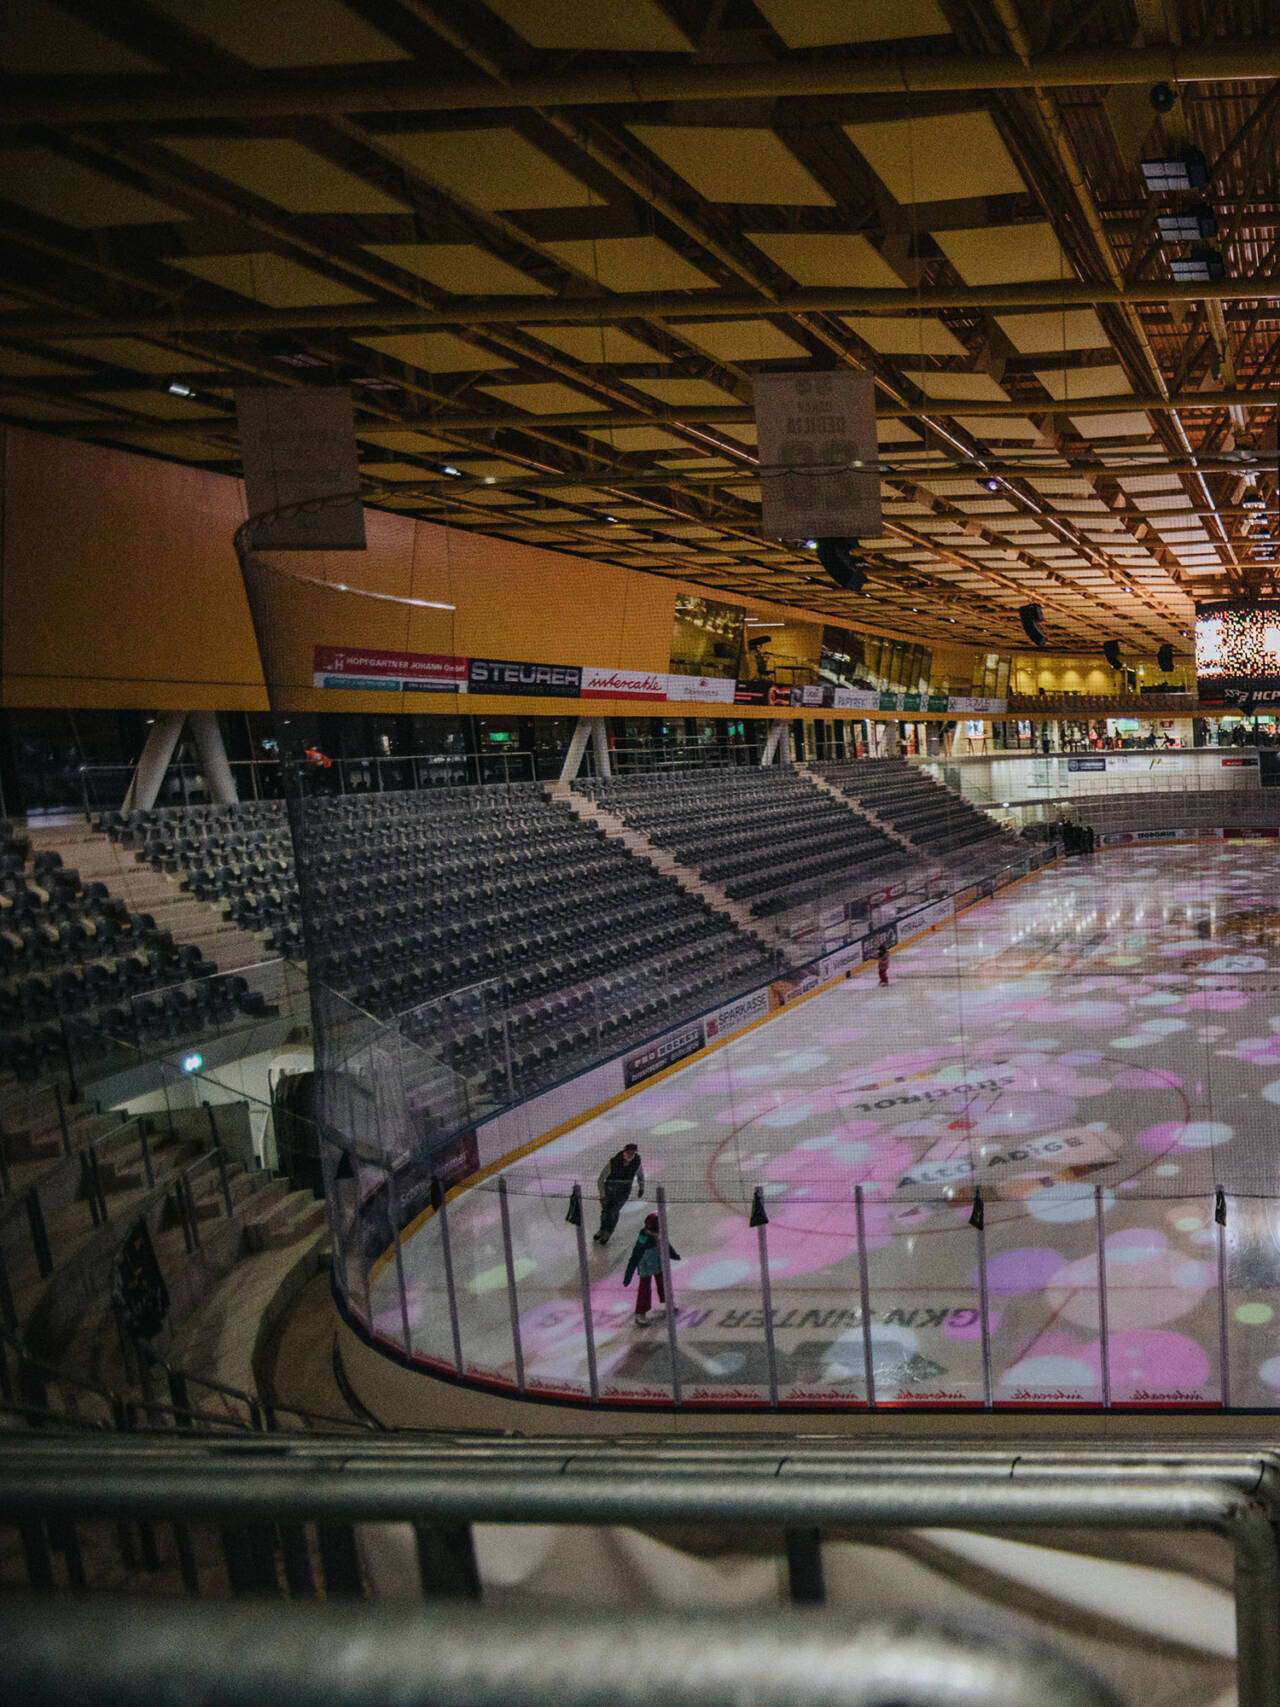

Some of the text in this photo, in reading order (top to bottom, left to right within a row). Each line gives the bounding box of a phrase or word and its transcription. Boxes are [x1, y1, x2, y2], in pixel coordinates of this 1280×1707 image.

[471, 661, 579, 686] STEURER
[588, 672, 662, 691] intercable
[717, 992, 768, 1027] SPARKASSE
